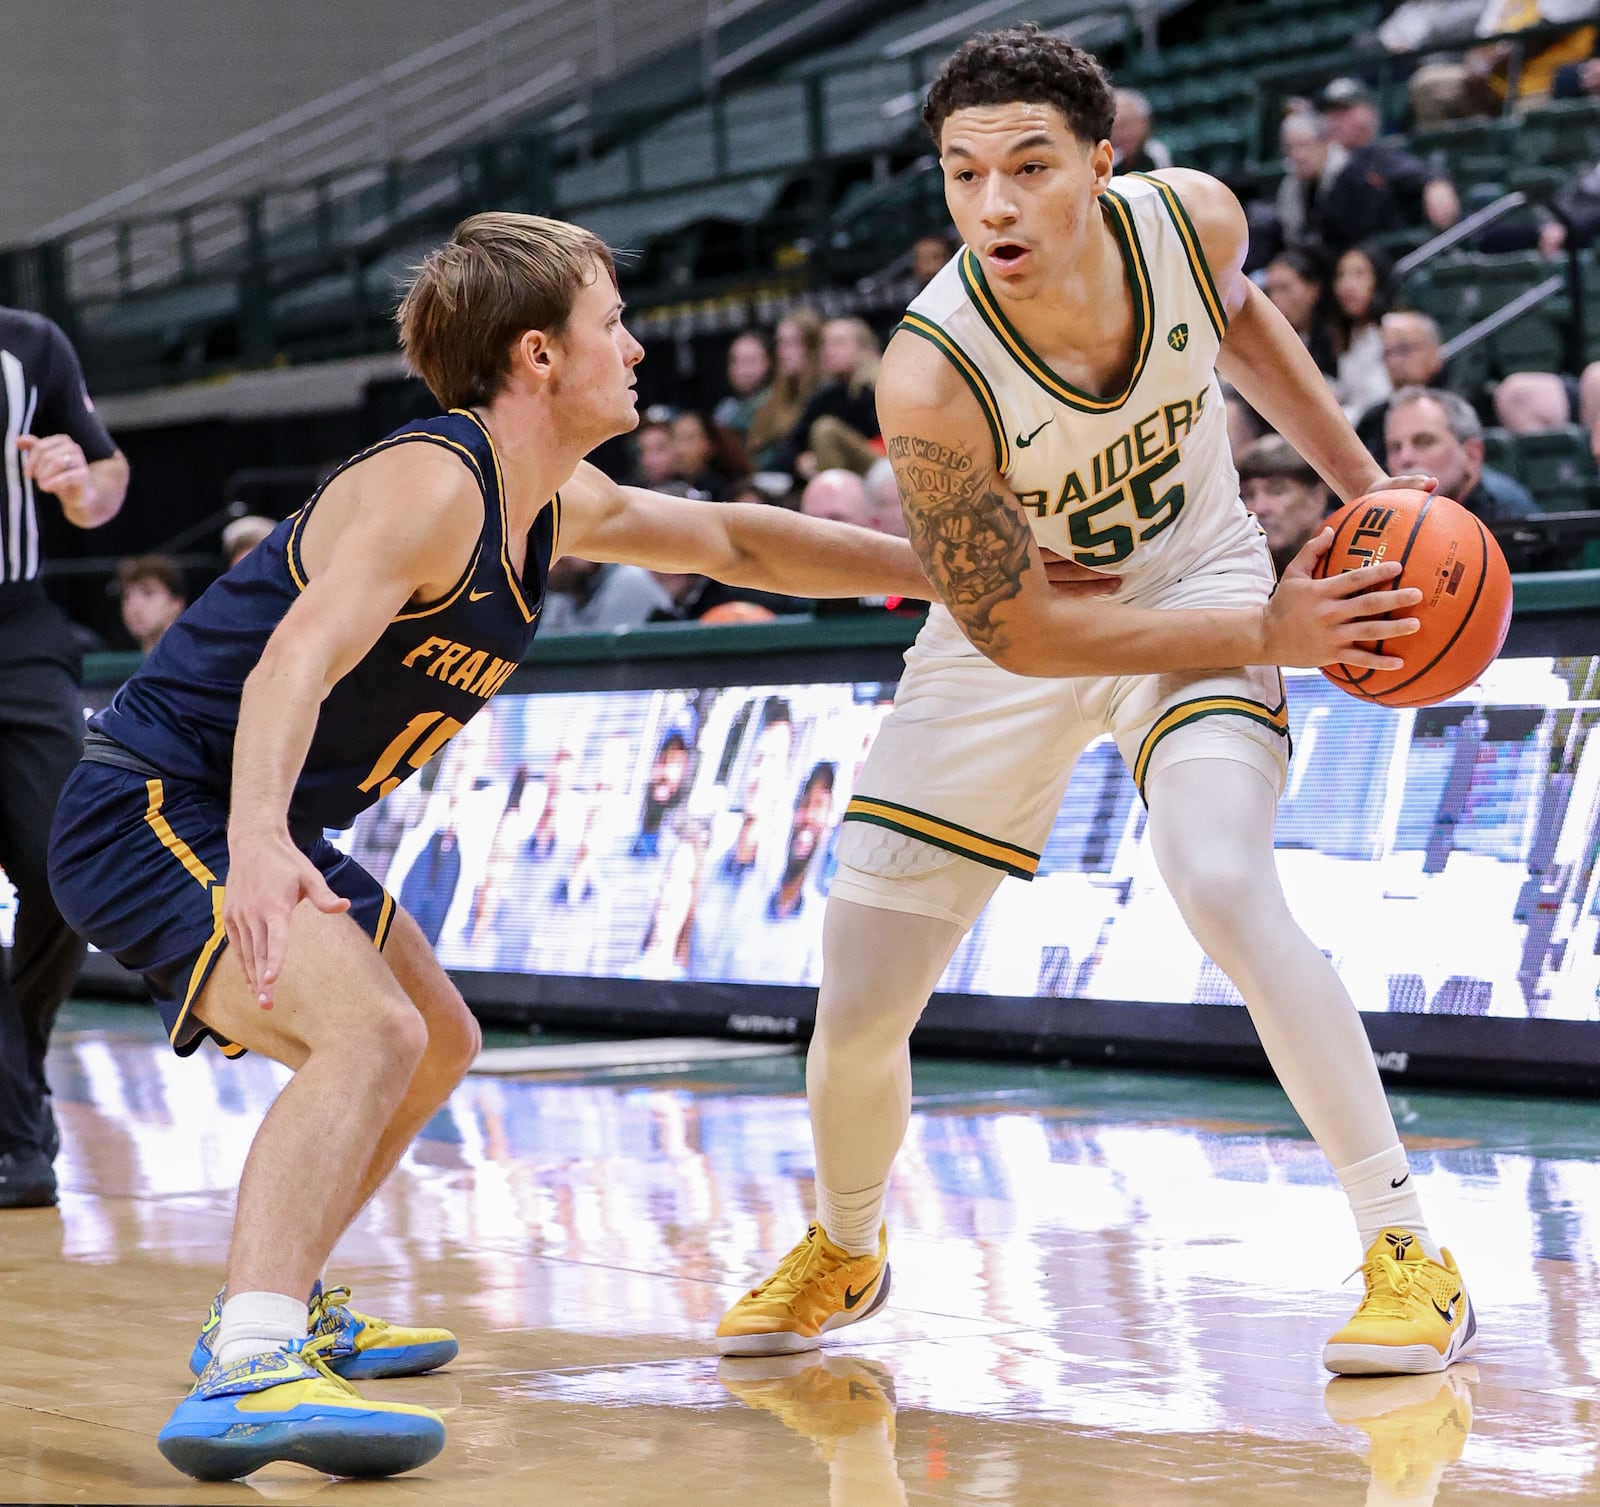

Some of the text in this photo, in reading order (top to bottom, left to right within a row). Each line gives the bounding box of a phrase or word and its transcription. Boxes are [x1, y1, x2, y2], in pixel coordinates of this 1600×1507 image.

[911, 437, 973, 472] WORLD
[906, 462, 976, 498] YOURS
[1066, 445, 1186, 569] 55
